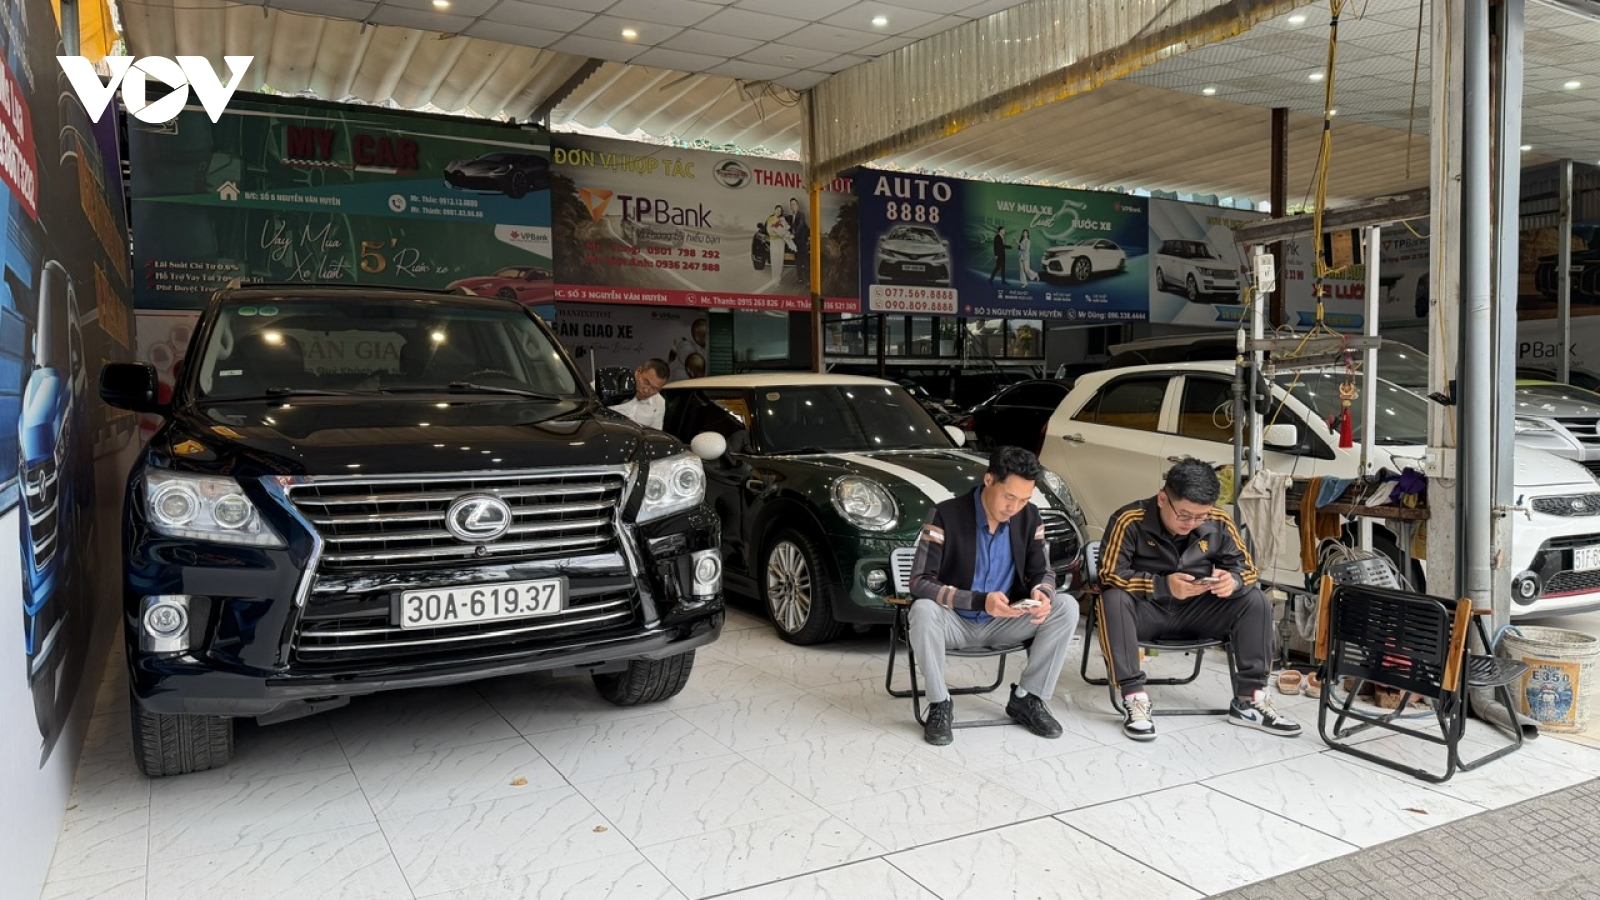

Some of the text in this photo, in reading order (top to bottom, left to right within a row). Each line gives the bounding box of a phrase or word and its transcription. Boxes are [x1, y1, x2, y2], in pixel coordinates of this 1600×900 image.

[287, 127, 419, 169] MY CAR
[553, 147, 595, 168] ĐƠN
[599, 153, 617, 174] VỊ
[622, 154, 659, 176] HỢP
[663, 157, 696, 180] TÁC
[873, 176, 952, 202] AUTO
[617, 195, 712, 229] TPBank
[886, 201, 940, 224] 8888
[996, 200, 1053, 216] VAY MUA XE
[1099, 221, 1112, 231] XE
[260, 218, 342, 262] Vay Mua
[520, 231, 548, 240] VPBank
[647, 245, 672, 256] 0901
[678, 248, 696, 257] 798
[702, 250, 720, 259] 292
[285, 250, 313, 282] Xe
[655, 259, 680, 270] 0936
[567, 288, 580, 299] SỐ
[581, 290, 587, 299] 3
[588, 289, 621, 301] NGUYỄN
[623, 291, 640, 302] VĂN
[884, 288, 953, 300] 077.569.8888
[884, 300, 953, 311] 090.809.8888
[583, 323, 613, 338] GIAO
[617, 325, 633, 339] XE
[407, 584, 556, 623] 30A-619.37
